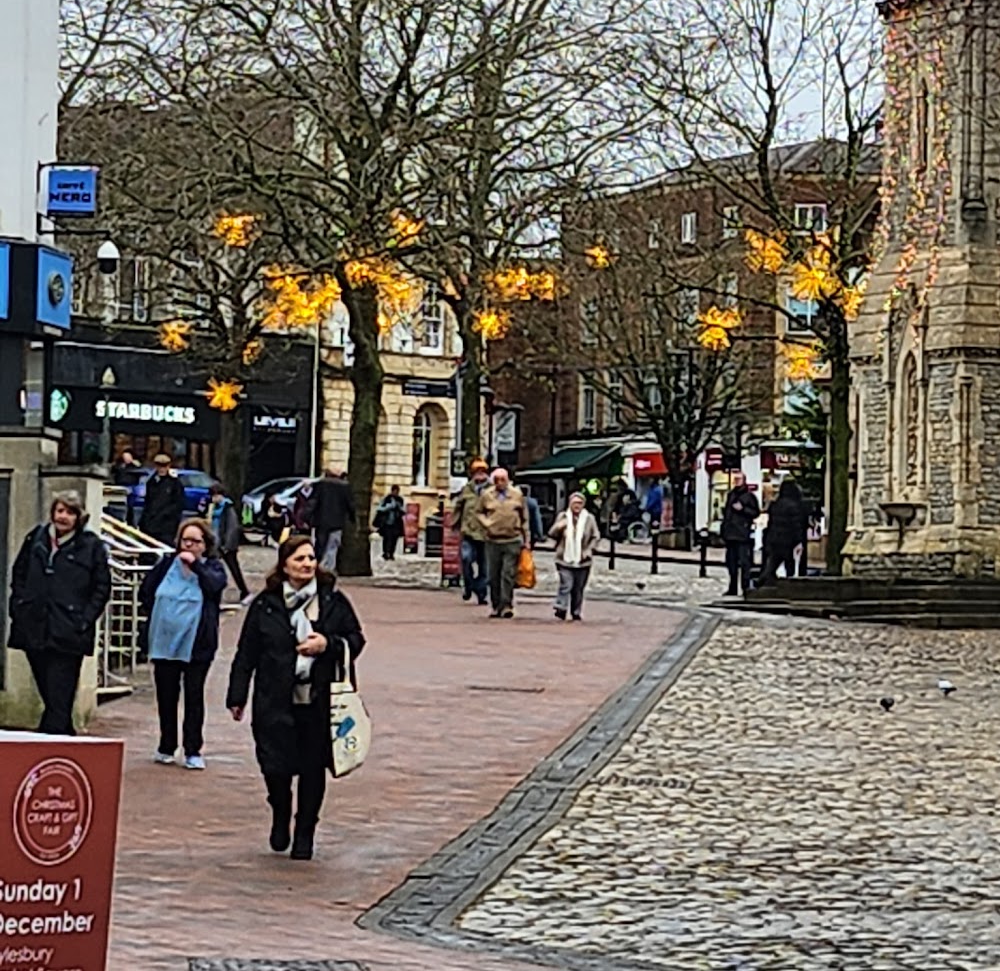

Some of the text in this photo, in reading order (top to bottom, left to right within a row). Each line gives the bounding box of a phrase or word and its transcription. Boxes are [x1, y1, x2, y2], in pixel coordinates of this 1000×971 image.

[49, 192, 91, 203] NERO
[96, 400, 196, 424] STARBUCKS
[73, 878, 81, 901] 1
